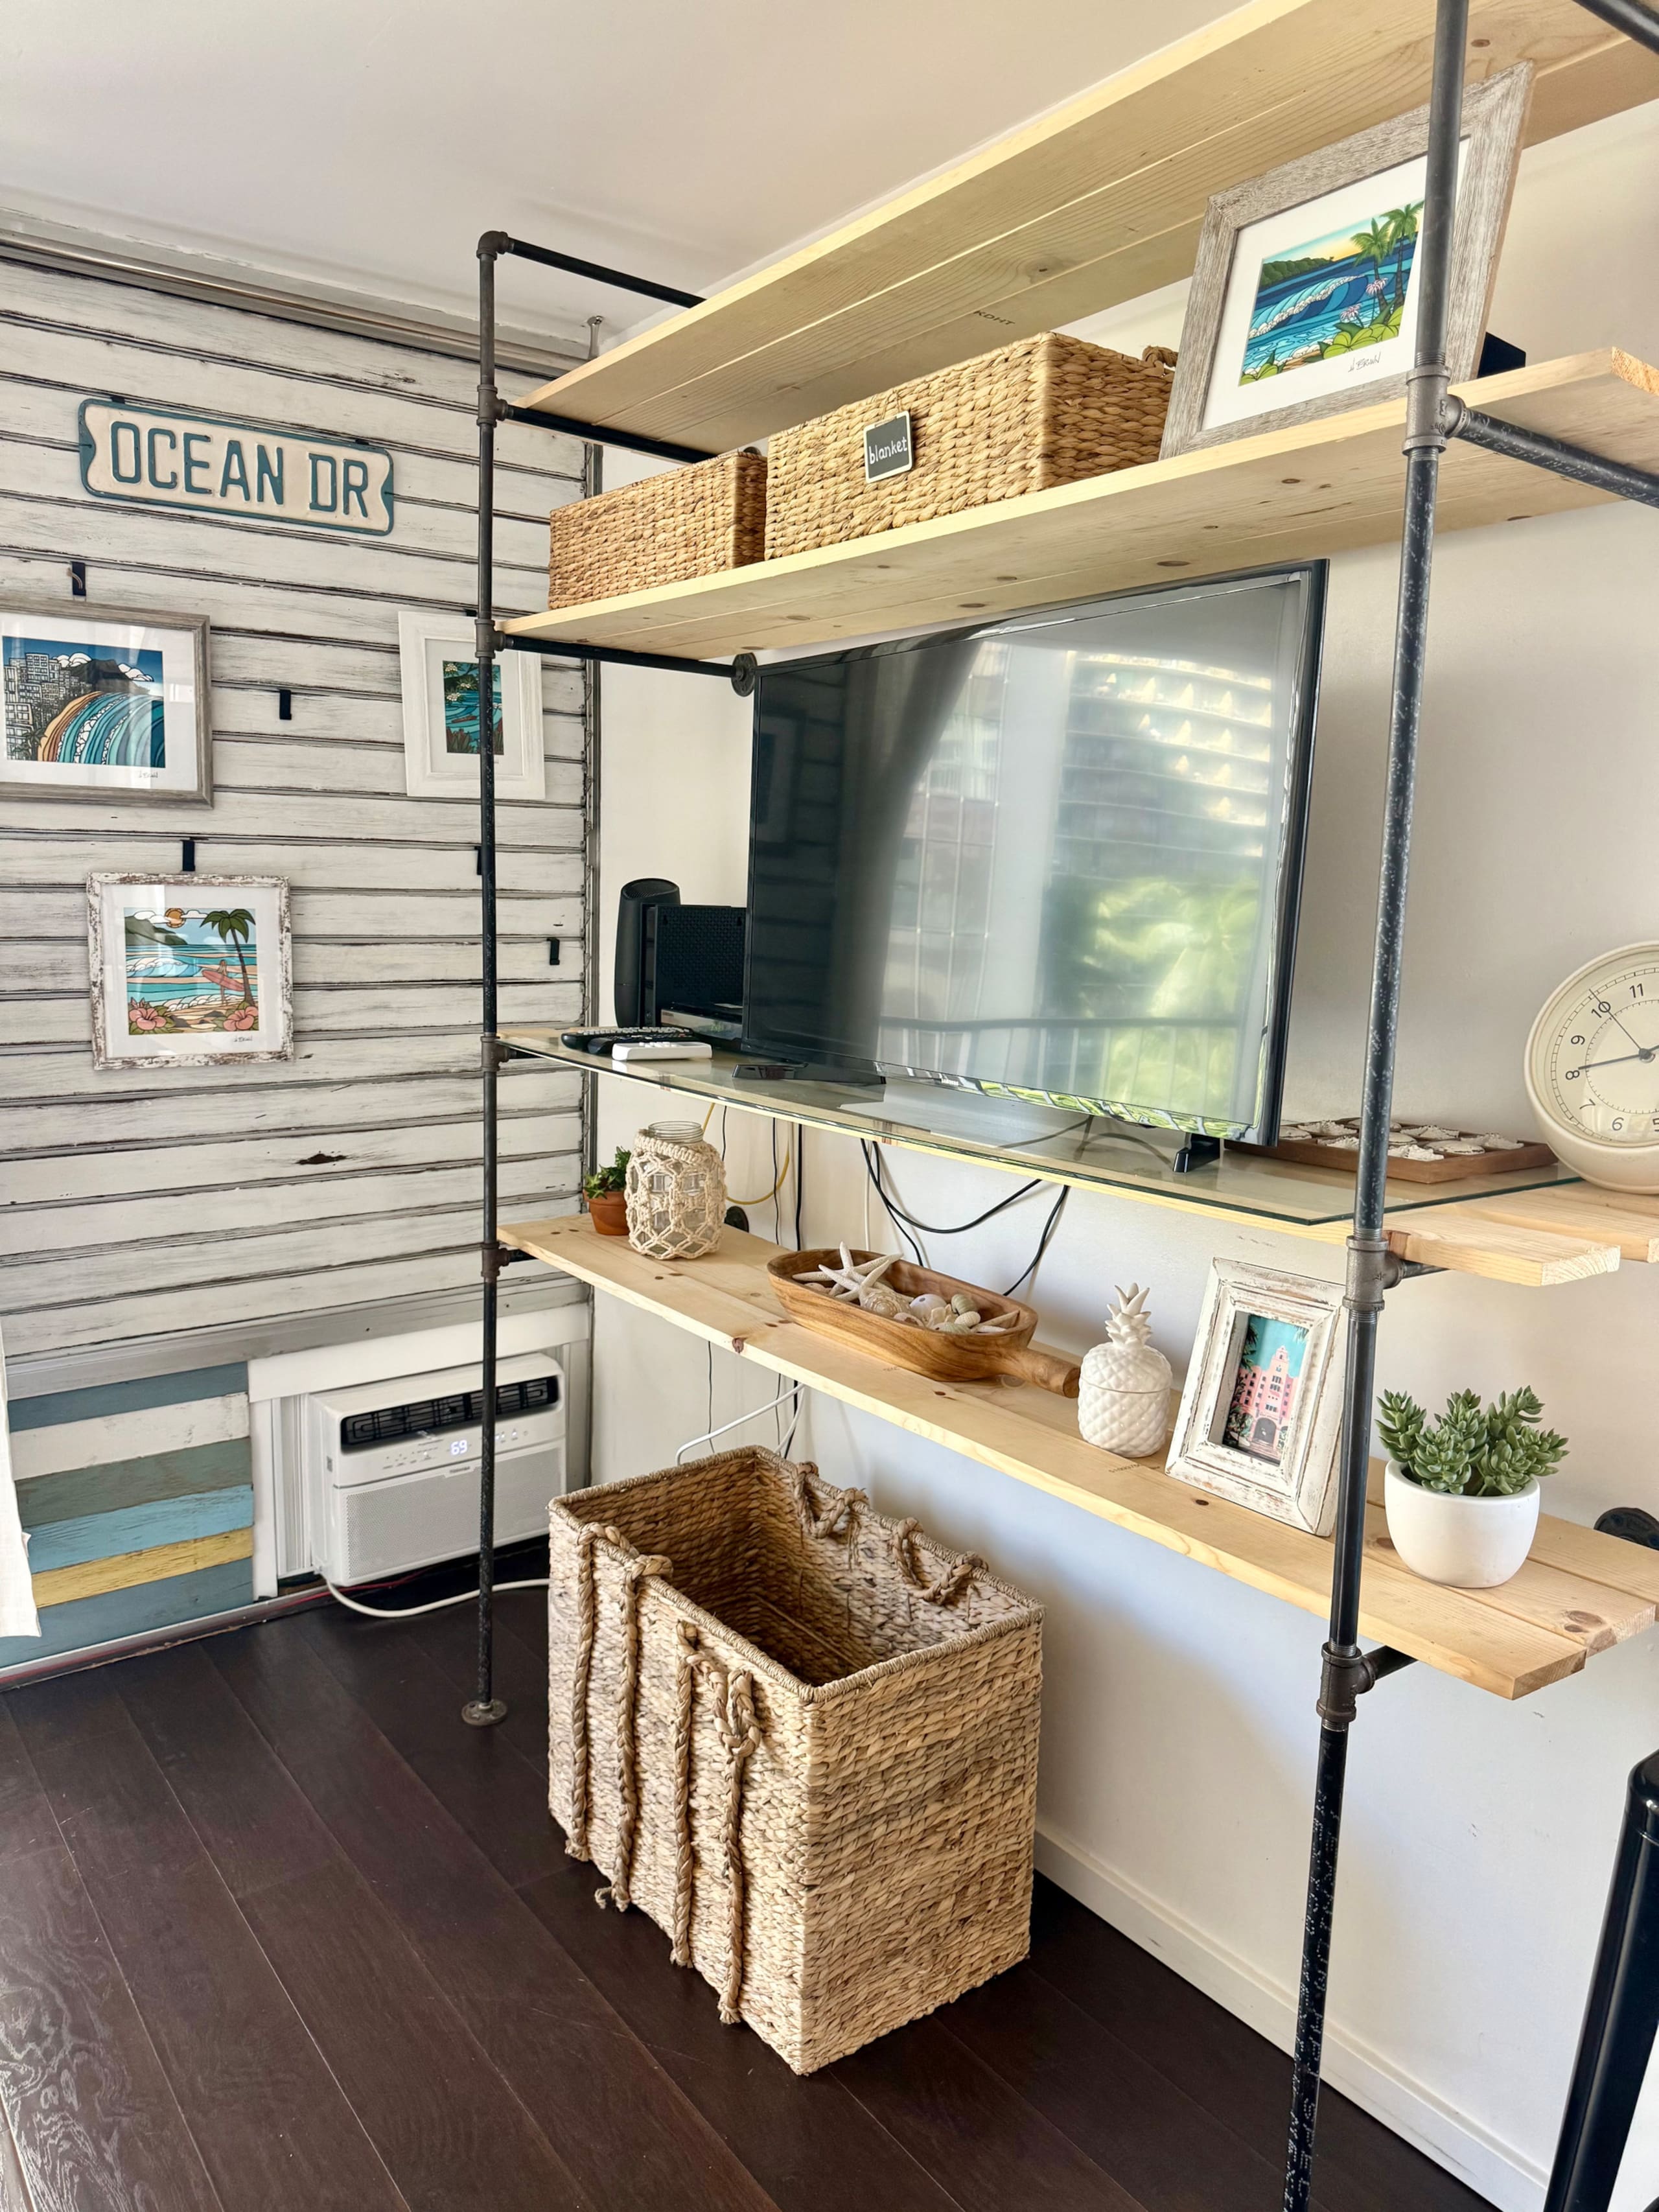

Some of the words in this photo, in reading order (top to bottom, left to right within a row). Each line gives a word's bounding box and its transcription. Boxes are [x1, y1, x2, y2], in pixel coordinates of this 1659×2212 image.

[973, 310, 1015, 325] KDHT
[869, 437, 907, 465] blanket
[111, 421, 283, 505] OCEAN
[308, 453, 368, 517] DR
[1629, 983, 1643, 998] 11
[1591, 1001, 1611, 1018] 10
[1571, 1035, 1585, 1045] 9
[1565, 1070, 1580, 1080] 8
[1579, 1099, 1596, 1110] 7
[1612, 1117, 1624, 1131] 6
[451, 1440, 467, 1455] 69
